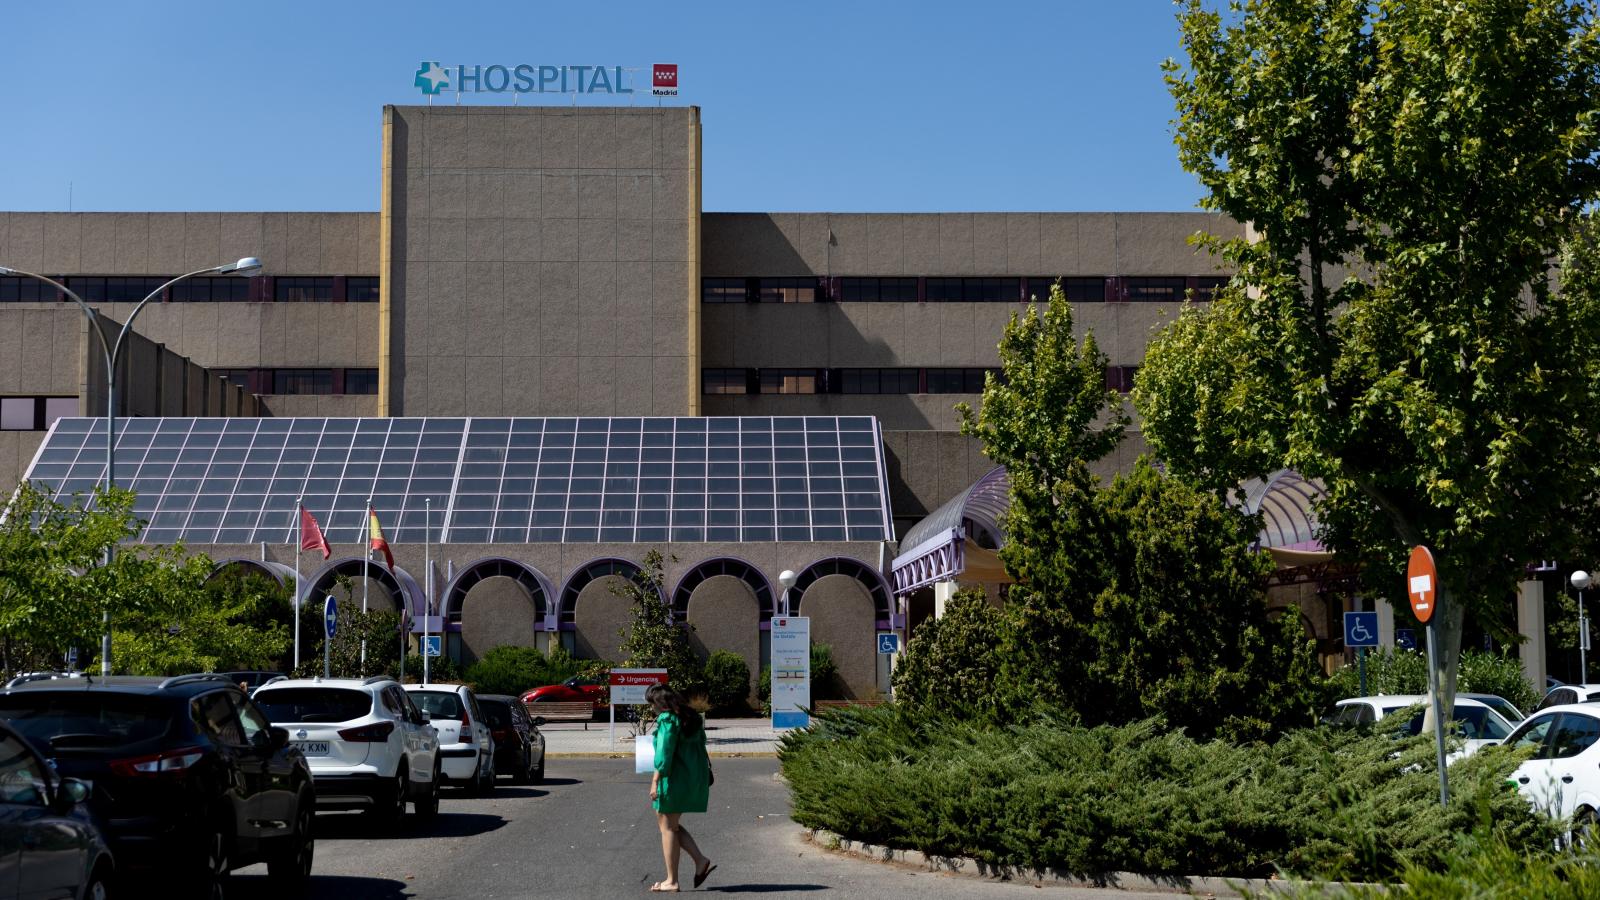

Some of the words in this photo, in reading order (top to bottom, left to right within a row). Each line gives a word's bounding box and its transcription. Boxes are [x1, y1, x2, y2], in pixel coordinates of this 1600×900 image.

[458, 64, 633, 93] HOSPITAL
[626, 676, 659, 684] Urgencias
[308, 743, 327, 752] KXN
